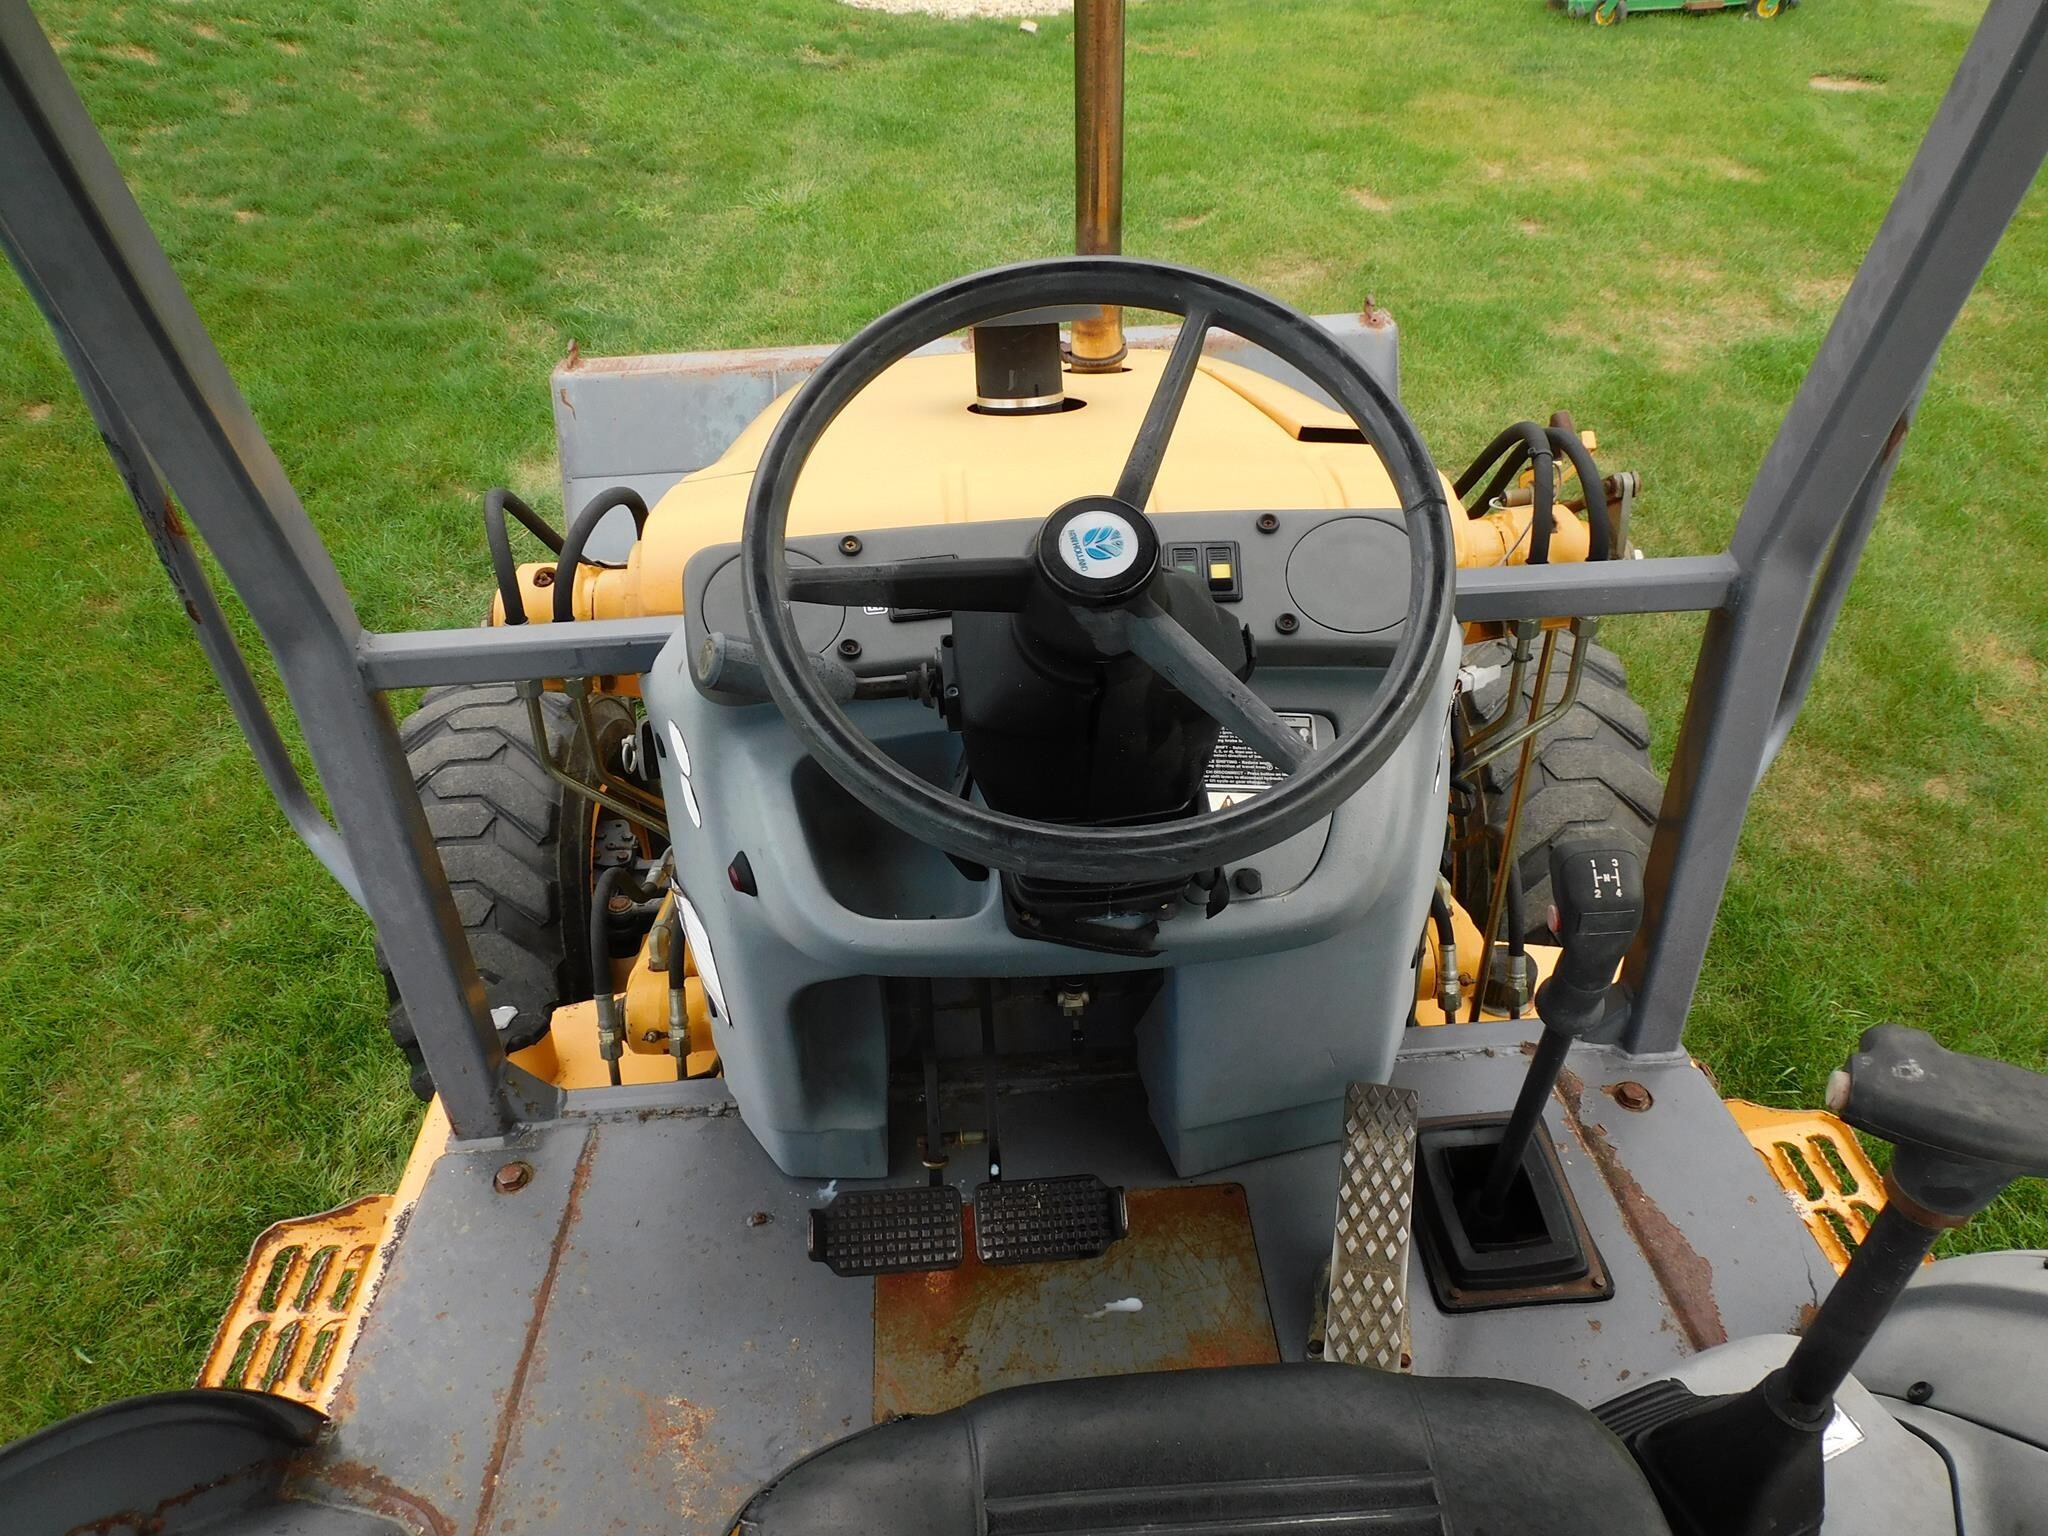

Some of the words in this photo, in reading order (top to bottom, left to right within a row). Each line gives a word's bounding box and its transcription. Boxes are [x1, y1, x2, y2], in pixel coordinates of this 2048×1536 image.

[1590, 859, 1596, 868] 1
[1611, 858, 1619, 867] 3
[1603, 873, 1611, 882] N
[1594, 889, 1602, 898] 2
[1616, 888, 1623, 897] 4
